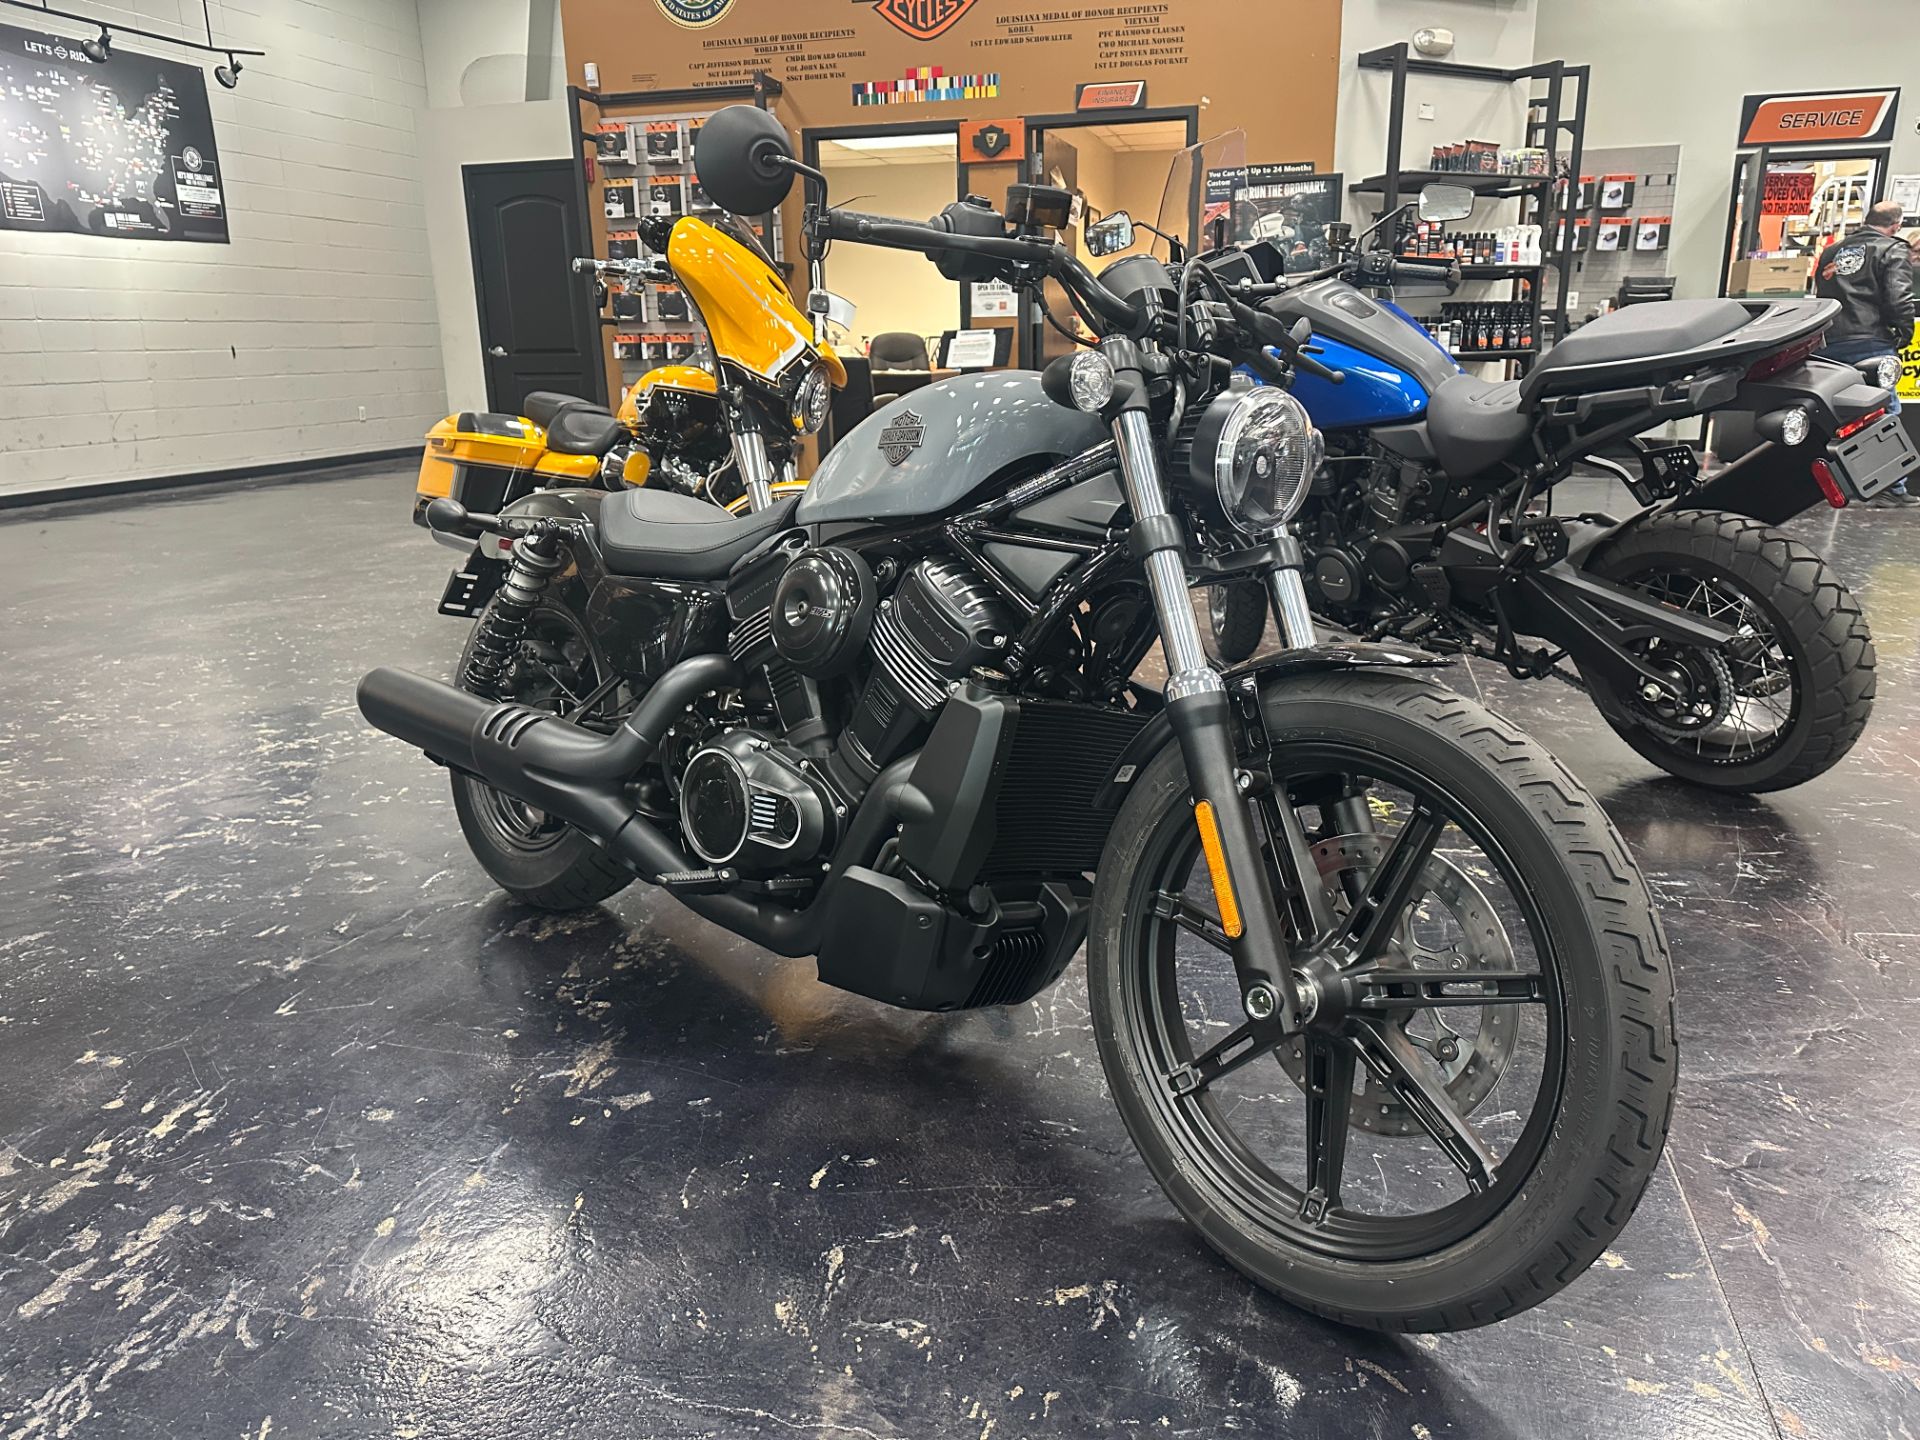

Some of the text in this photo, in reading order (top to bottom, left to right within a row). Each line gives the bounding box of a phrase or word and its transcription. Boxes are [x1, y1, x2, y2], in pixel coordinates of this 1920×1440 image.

[675, 7, 712, 19] STATES OF
[996, 4, 1169, 25] LOUISIANA MEDAL OF HONOR RECIPIENTS
[1124, 16, 1160, 25] VIETNAM
[1008, 26, 1034, 34] KOREA
[1099, 26, 1185, 38] PFC RAYMOND CLAUSEN
[702, 28, 856, 48] LOUISIANA MEDAL OF HONOR RECIPIENTS
[994, 37, 1024, 45] EDWARD
[1025, 33, 1073, 43] SCHOWALTER
[24, 40, 53, 56] LET'S
[754, 43, 803, 54] WORLD WAR II
[1120, 49, 1148, 57] STEVEN
[1149, 47, 1184, 55] BENNETT
[785, 51, 866, 63] CMDR HOWARD GILMORE
[1120, 59, 1153, 68] DOUGLAS
[1154, 57, 1189, 66] FOURNET
[706, 60, 742, 69] JEFFERSON
[1097, 88, 1128, 96] FINANCE
[1092, 95, 1135, 104] INSURANCE
[1779, 109, 1864, 129] SERVICE
[1251, 167, 1262, 176] Up
[1283, 164, 1312, 173] Months
[1765, 175, 1800, 187] SERVICE
[1267, 183, 1283, 198] THE
[1283, 180, 1327, 197] ORDINARY.
[1763, 187, 1812, 201] LOYEES ONLY
[1774, 202, 1789, 214] THIS
[1789, 202, 1810, 214] POINT
[977, 284, 988, 292] OPEN
